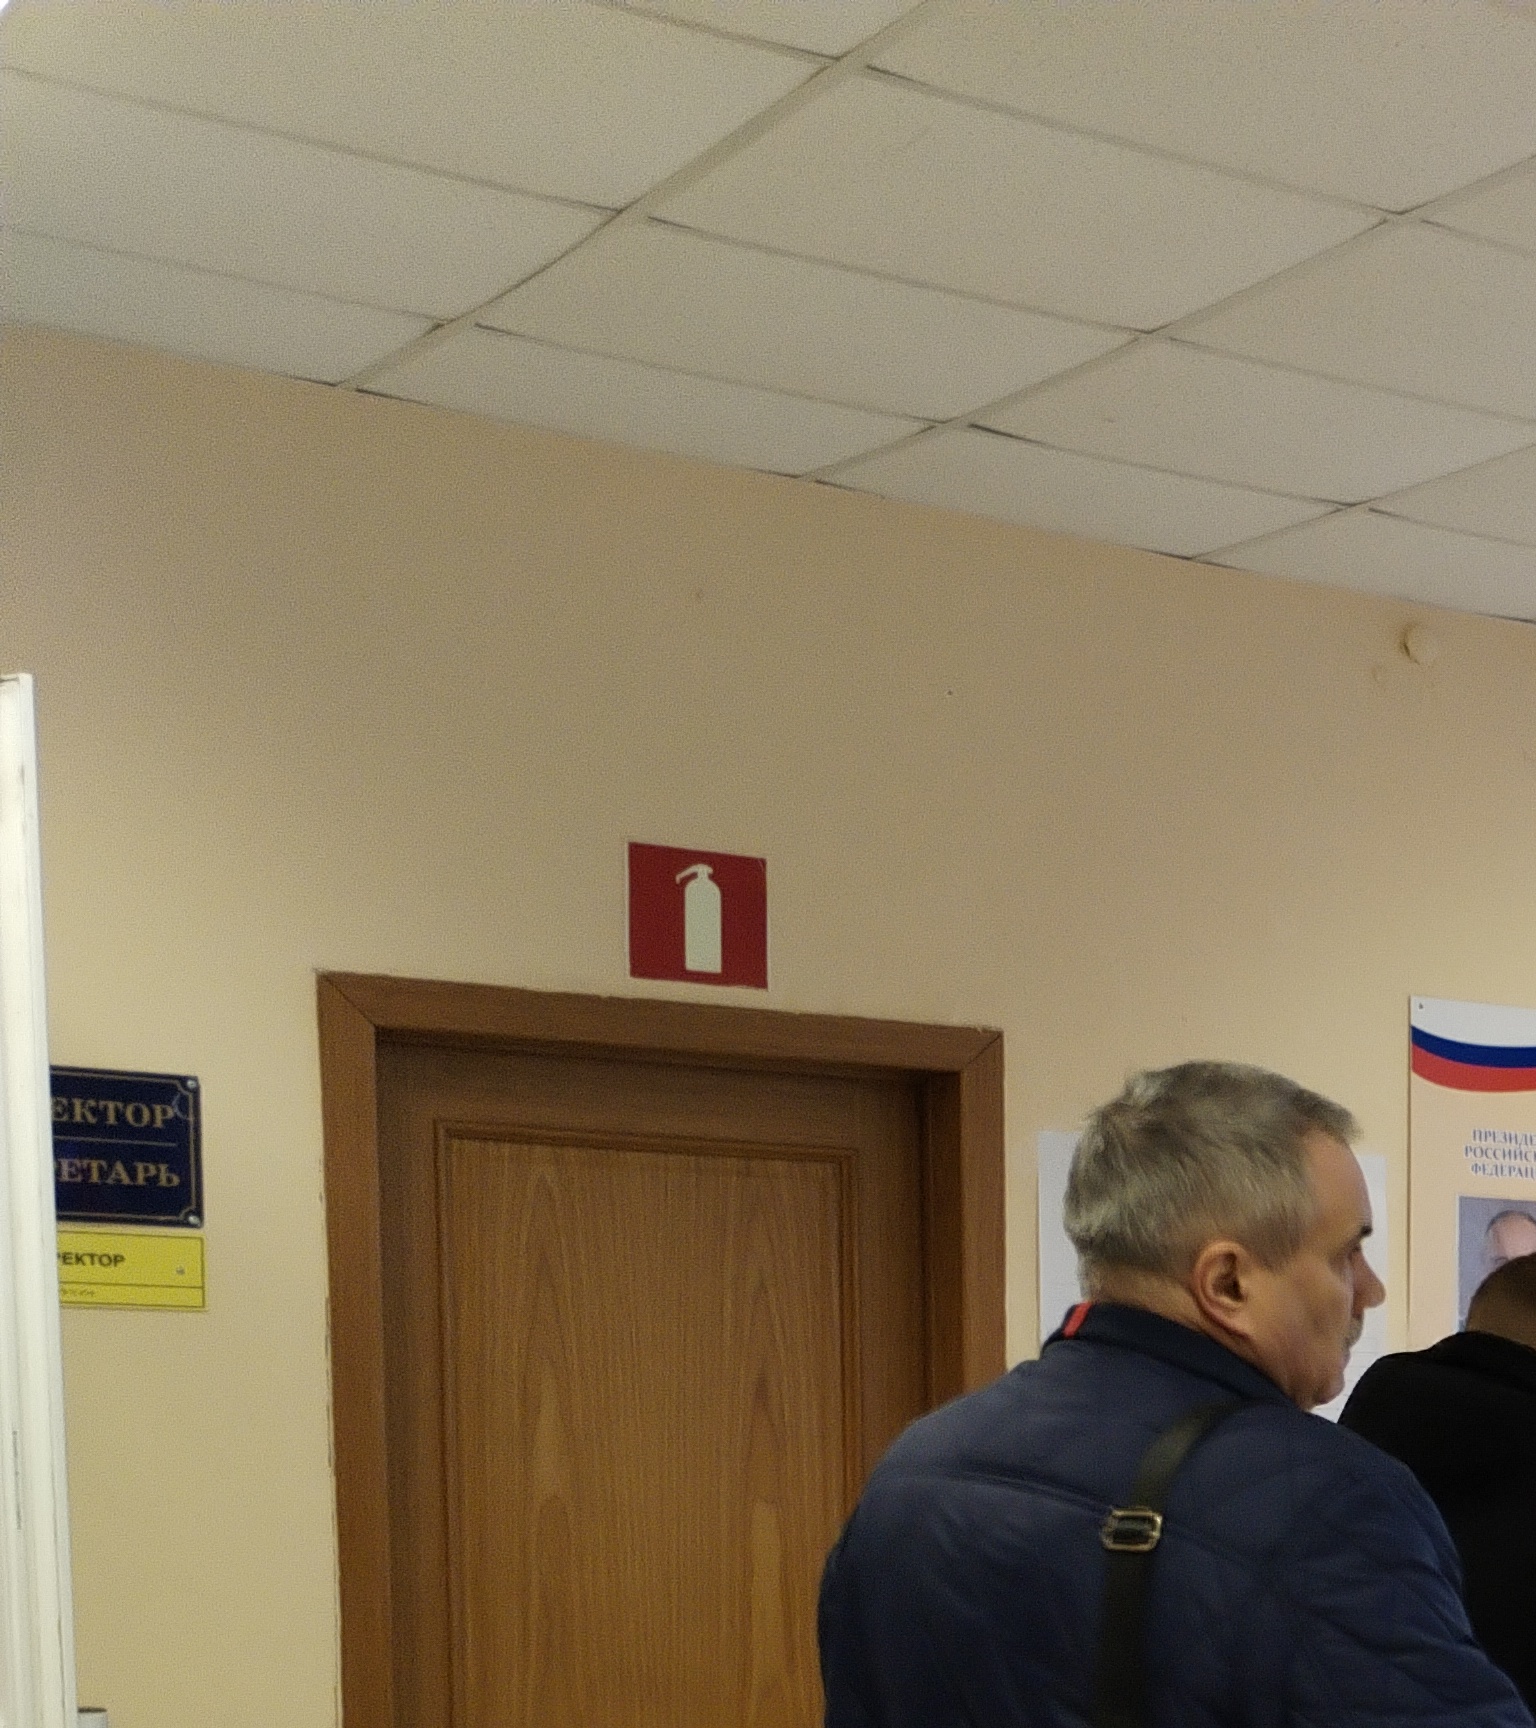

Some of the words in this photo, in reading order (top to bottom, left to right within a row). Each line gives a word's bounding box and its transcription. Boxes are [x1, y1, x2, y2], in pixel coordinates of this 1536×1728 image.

[51, 1097, 175, 1128] ЕКТОР
[54, 1157, 180, 1187] ЕТАРЬ
[57, 1252, 126, 1267] ЕКТОР
